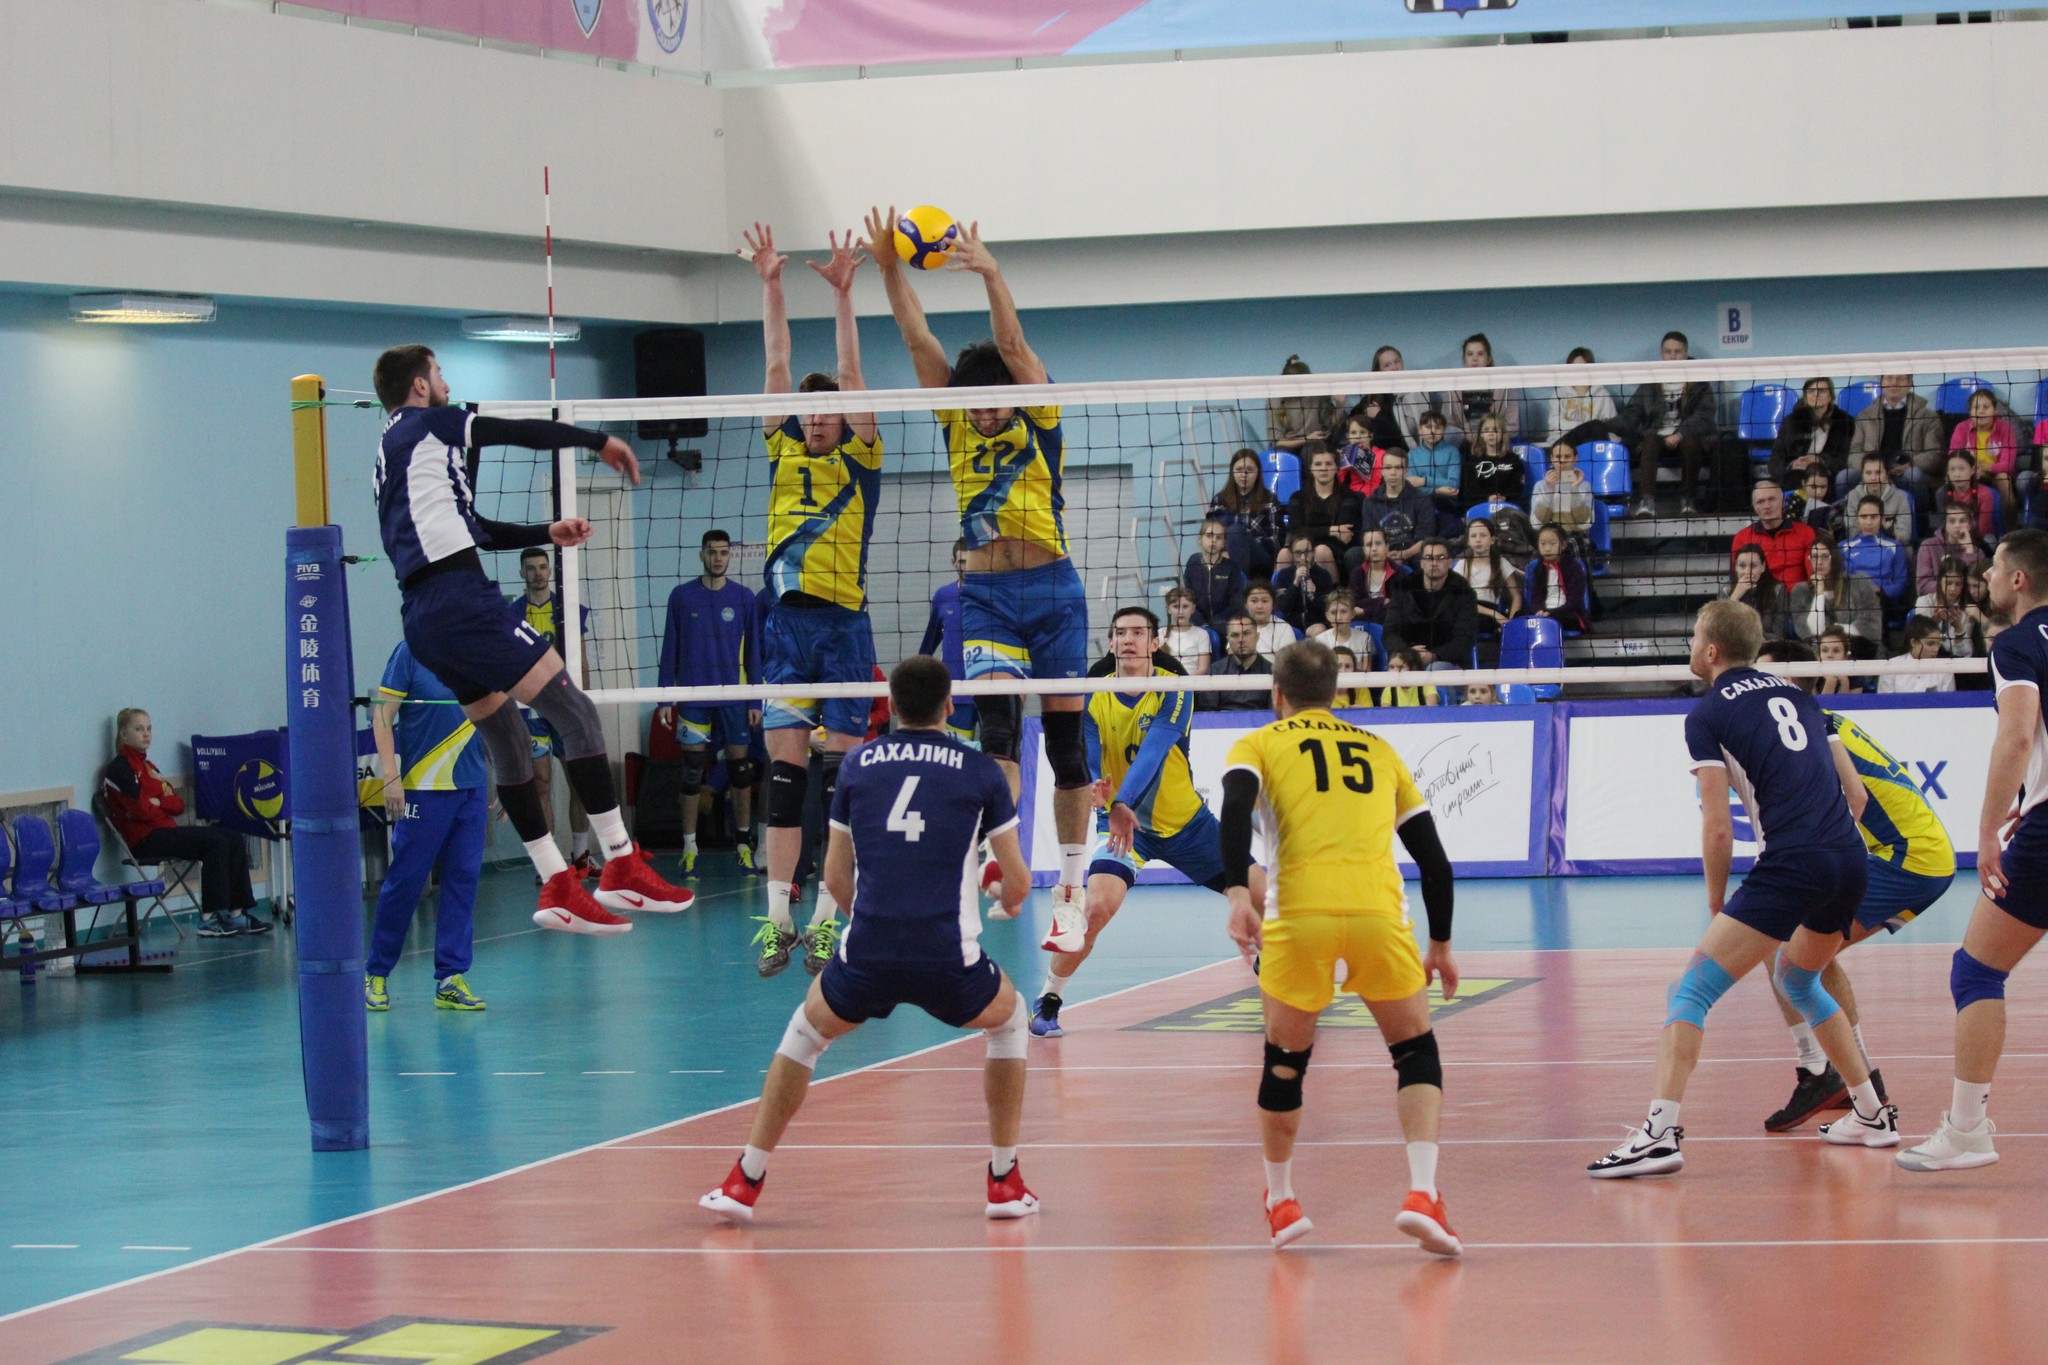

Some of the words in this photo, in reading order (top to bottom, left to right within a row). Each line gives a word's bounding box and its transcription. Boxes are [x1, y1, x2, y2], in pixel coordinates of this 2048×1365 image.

[1722, 334, 1750, 345] СЕКТОР
[972, 441, 1015, 474] 22
[797, 466, 819, 507] 1
[514, 620, 541, 646] 11
[300, 613, 321, 708] 金陵体育
[965, 645, 984, 669] 22
[1767, 697, 1808, 751] 8
[860, 743, 964, 769] САХАЛИН
[1299, 738, 1374, 794] 15
[887, 776, 925, 842] 4
